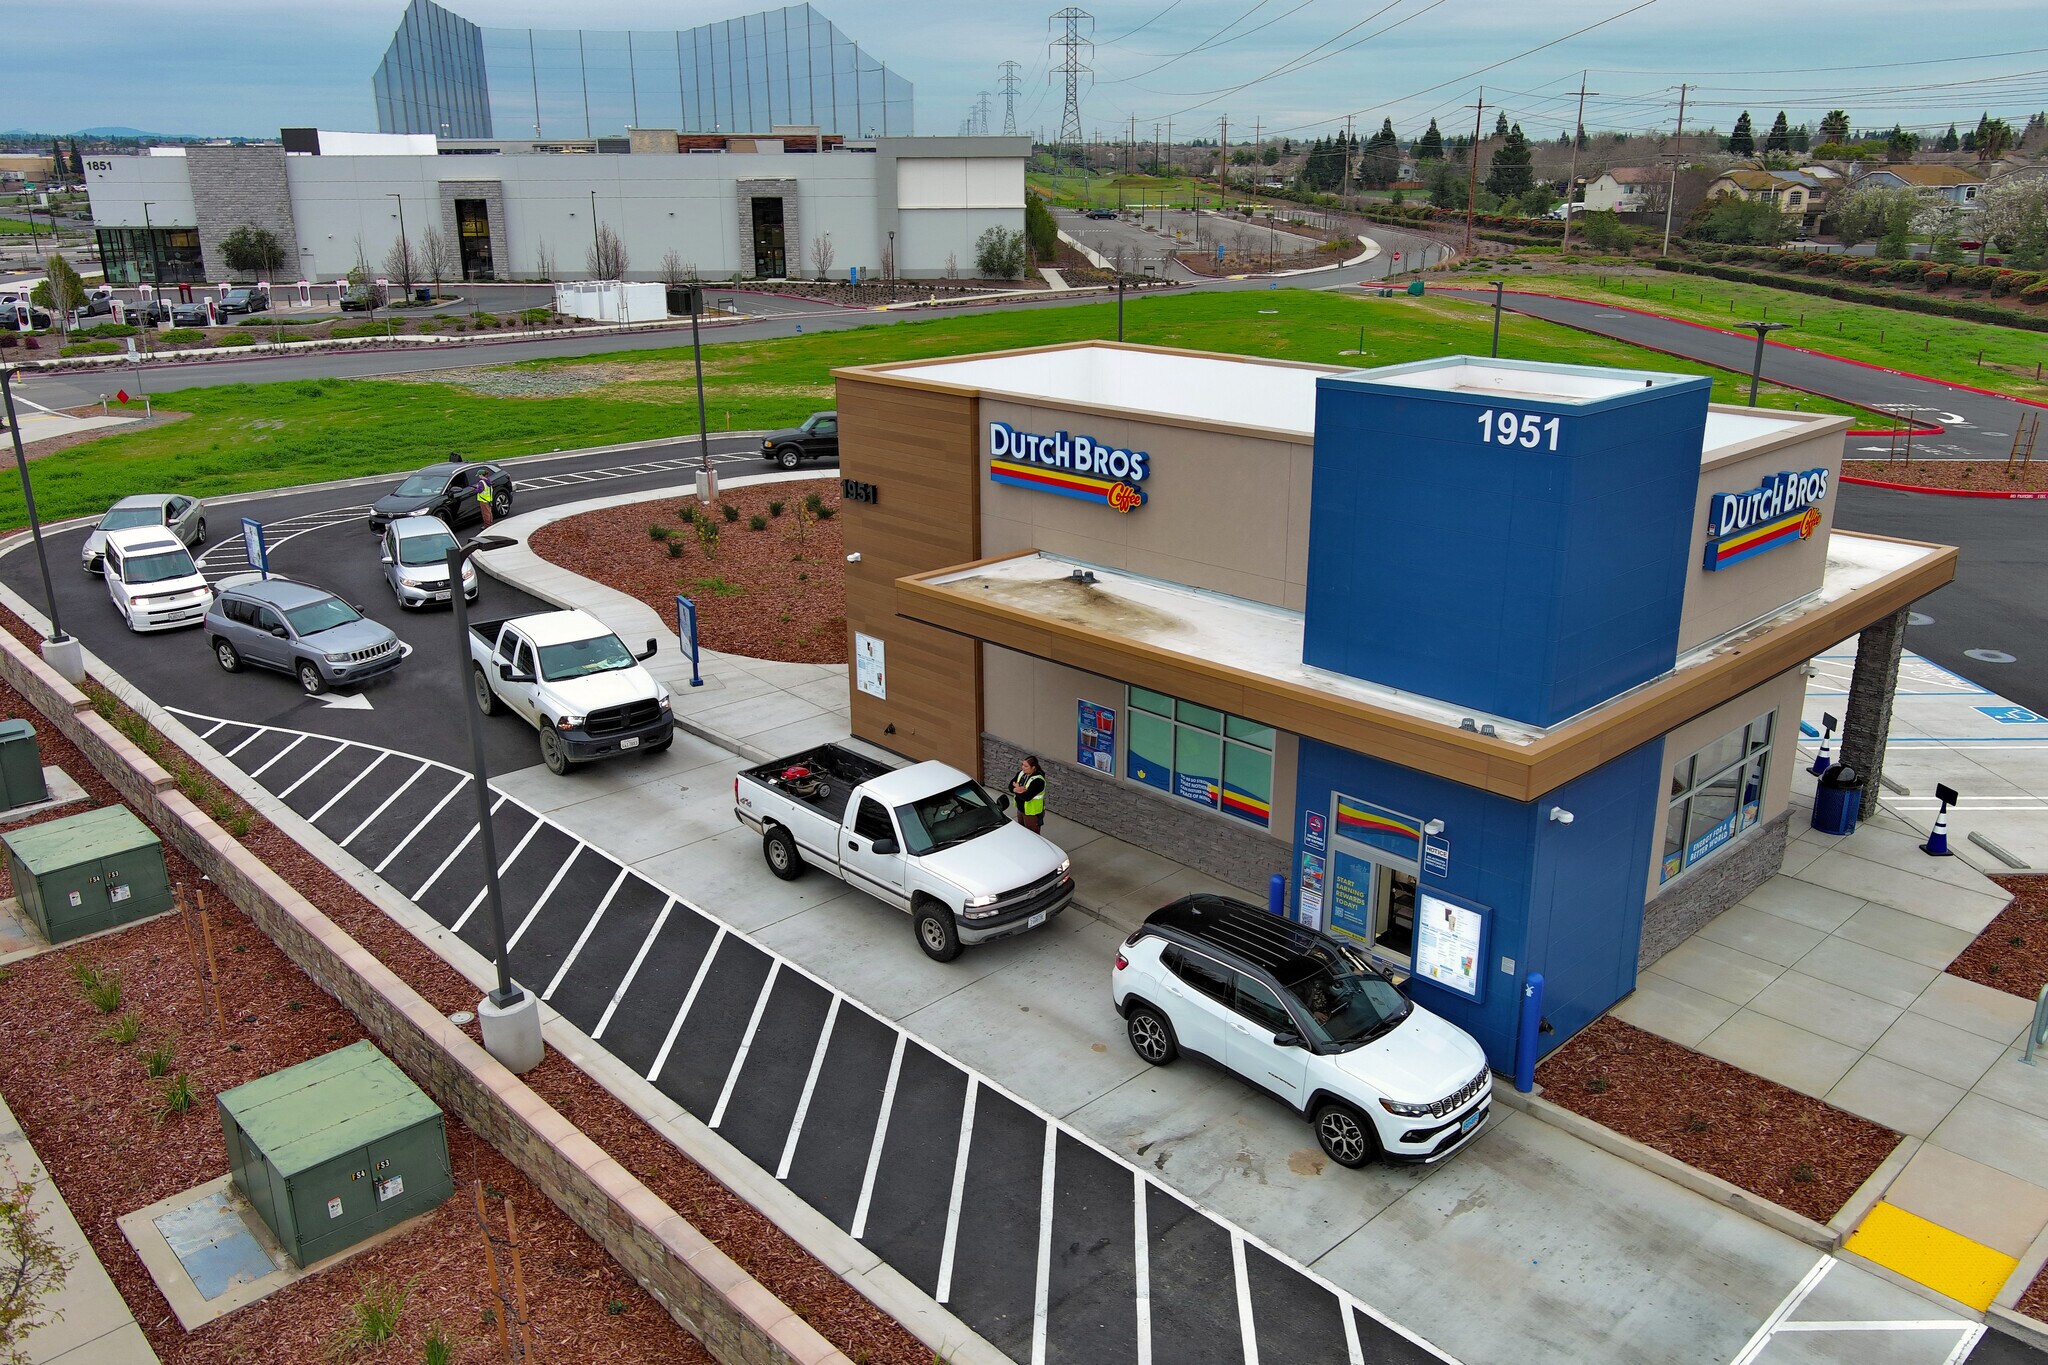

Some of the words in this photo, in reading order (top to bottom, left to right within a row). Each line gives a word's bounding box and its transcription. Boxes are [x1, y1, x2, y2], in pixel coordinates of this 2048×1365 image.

[86, 161, 112, 170] 1851
[1478, 410, 1560, 451] 1951
[990, 423, 1070, 468] DUTCH
[1075, 436, 1144, 481] BROS
[840, 479, 878, 504] 1951
[1108, 481, 1142, 513] Coffee
[1719, 477, 1784, 536] DUTCH
[1783, 469, 1829, 512] BROS
[1690, 844, 1708, 861] BETTER
[1708, 831, 1729, 848] WORLD
[1693, 833, 1712, 851] ENERGY
[1713, 826, 1723, 837] FOR
[1723, 823, 1727, 831] A
[1426, 846, 1448, 857] NOTICE
[1336, 876, 1355, 887] START
[1336, 883, 1365, 898] EARNING
[1335, 890, 1366, 906] REWARDS
[1335, 897, 1358, 911] TODAY!
[376, 1160, 390, 1170] FS3
